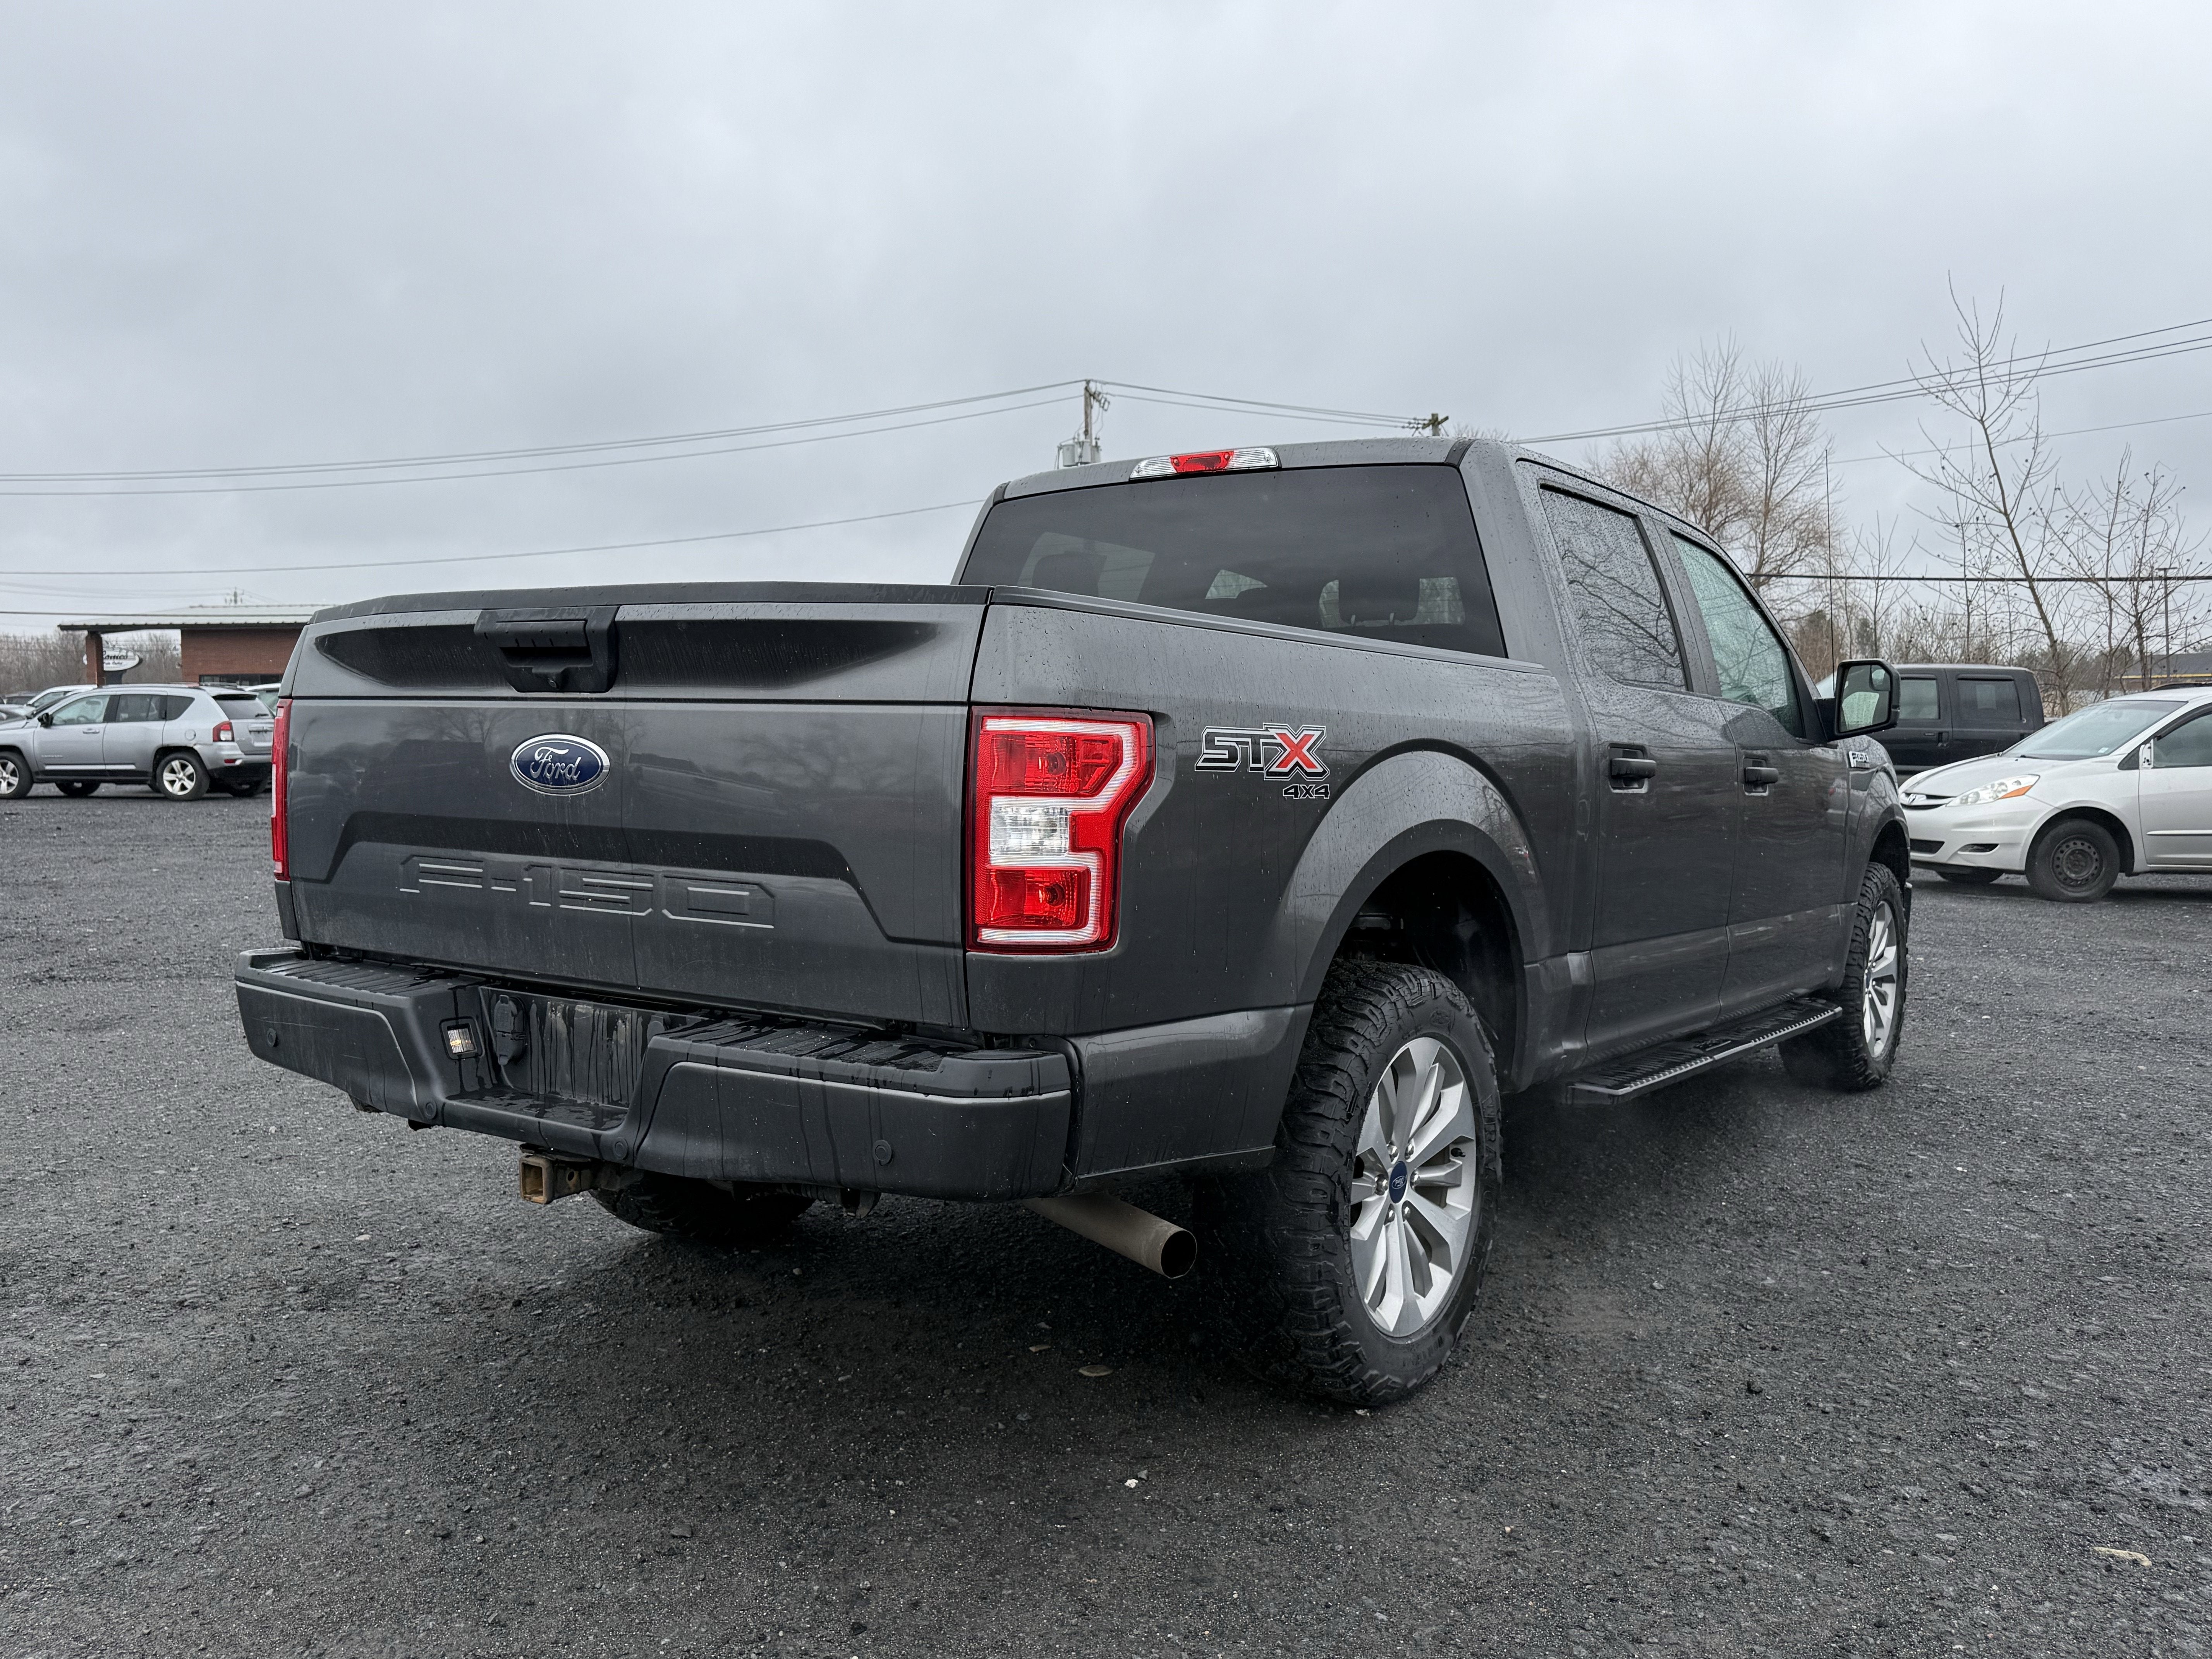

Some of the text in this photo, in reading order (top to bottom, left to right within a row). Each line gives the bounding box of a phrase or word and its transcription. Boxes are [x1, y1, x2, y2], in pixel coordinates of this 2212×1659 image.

[530, 747, 582, 780] Ford
[1195, 723, 1330, 780] STX
[400, 855, 774, 928] F-150
